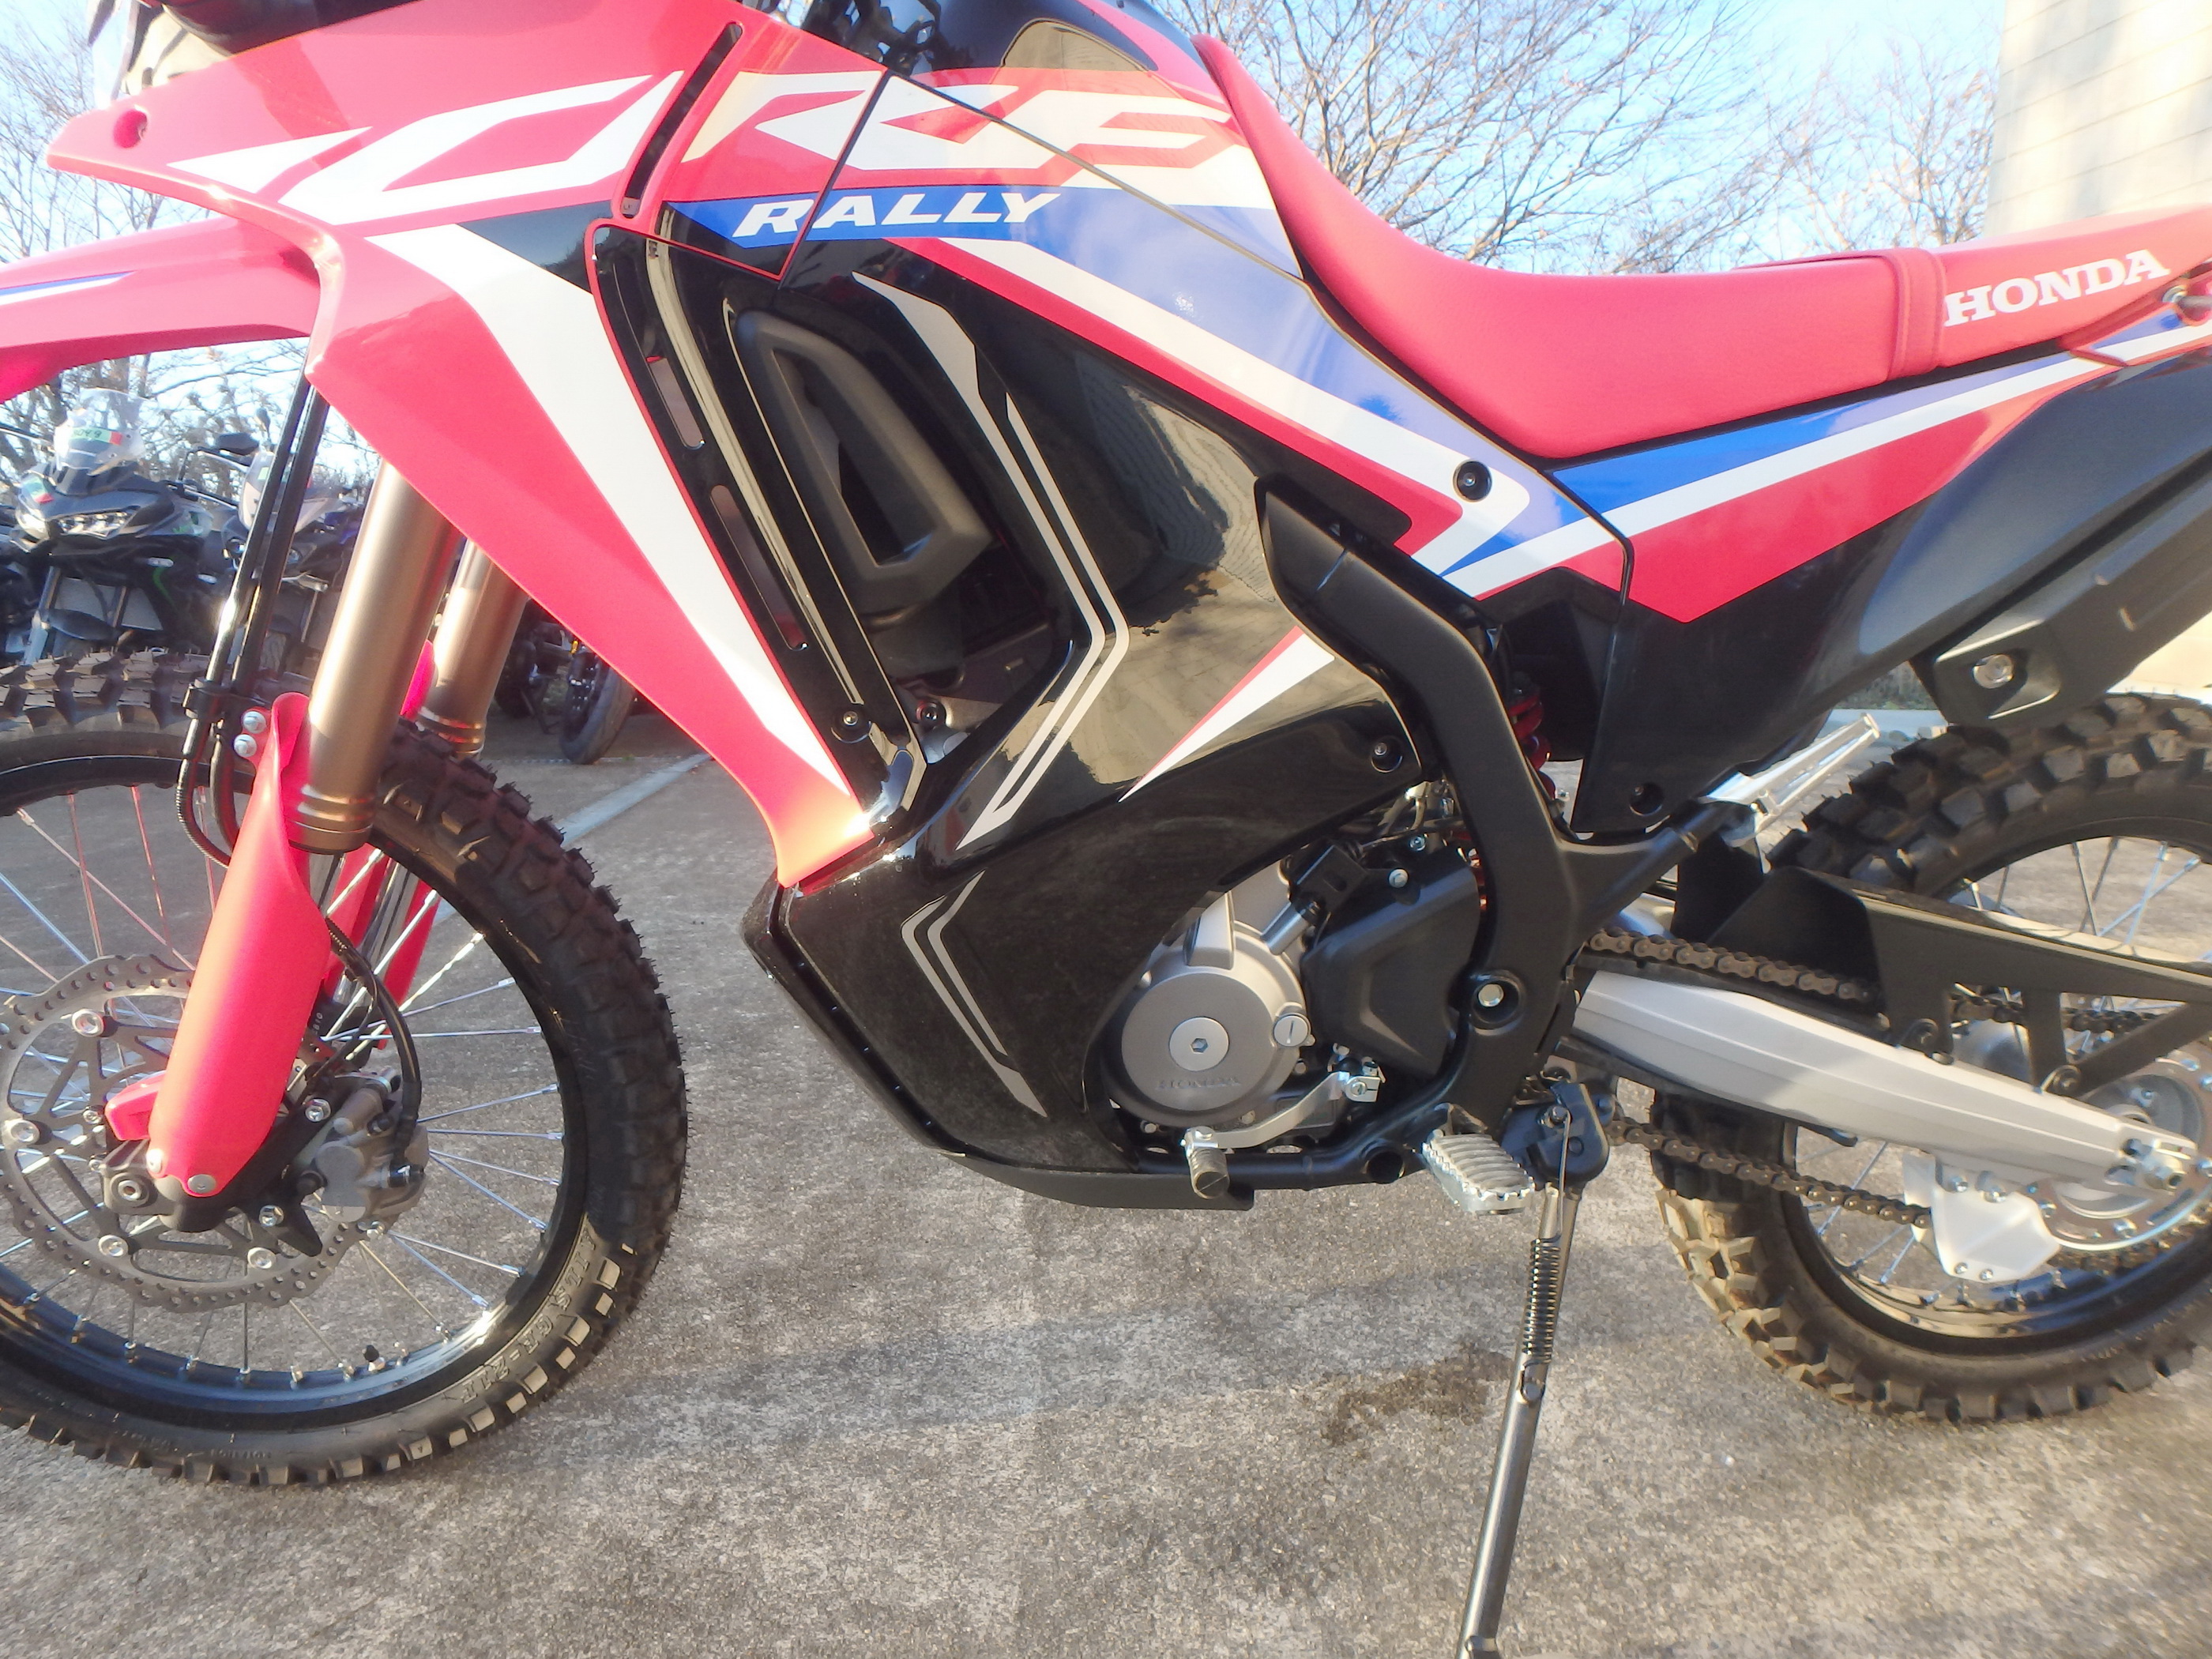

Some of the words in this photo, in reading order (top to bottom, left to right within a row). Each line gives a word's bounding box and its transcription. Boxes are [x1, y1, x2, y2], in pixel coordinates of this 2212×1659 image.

[732, 193, 1061, 238] RALLY
[1943, 249, 2171, 326] HONDA
[1155, 1077, 1241, 1090] HONDA
